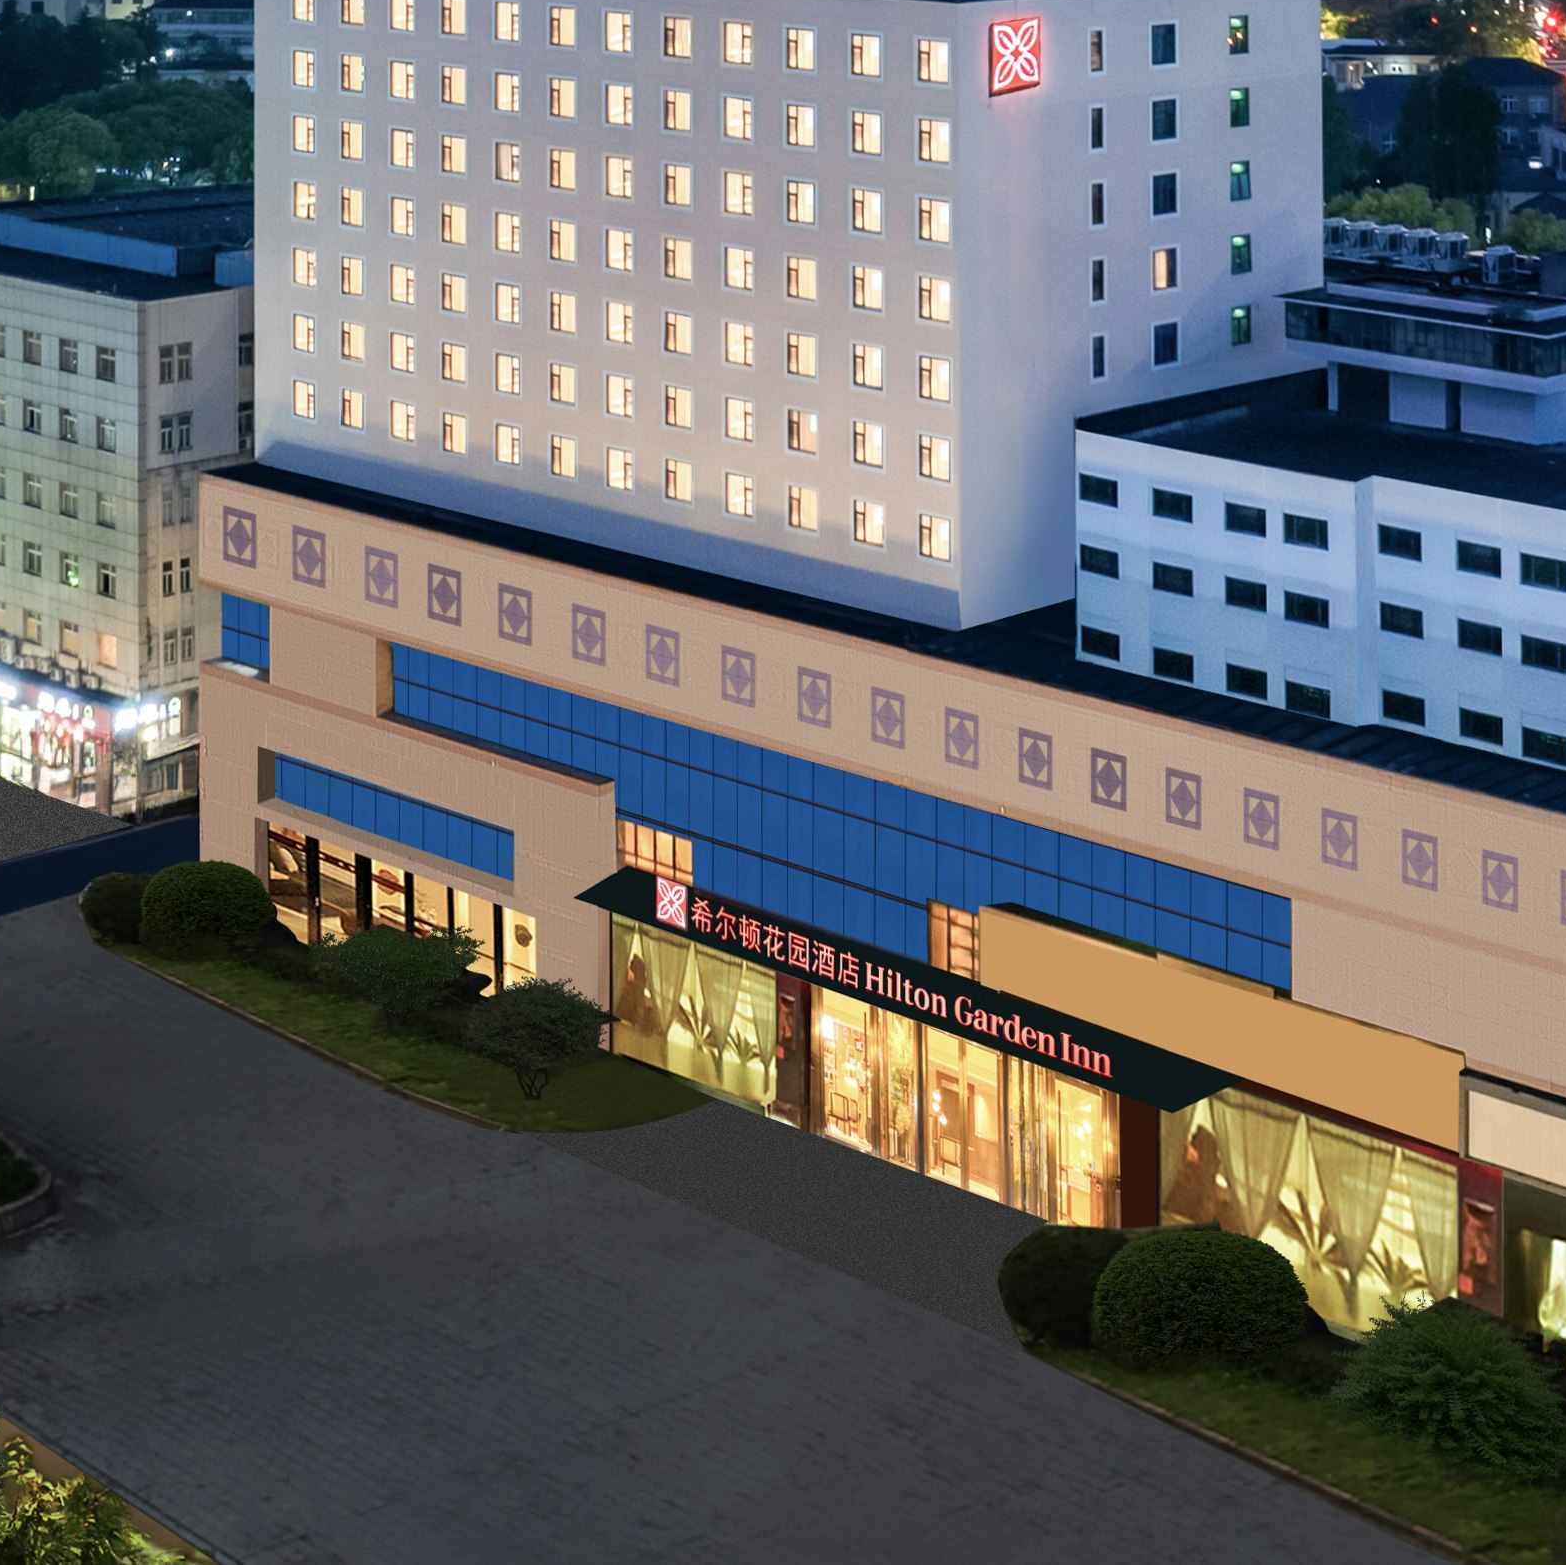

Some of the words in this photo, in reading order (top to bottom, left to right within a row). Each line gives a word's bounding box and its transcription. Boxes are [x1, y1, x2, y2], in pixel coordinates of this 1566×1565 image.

[691, 896, 860, 989] 希尔顿花园酒店
[865, 961, 947, 1018] Hilton
[954, 996, 1057, 1058] Garden
[1060, 1032, 1113, 1078] Inn
